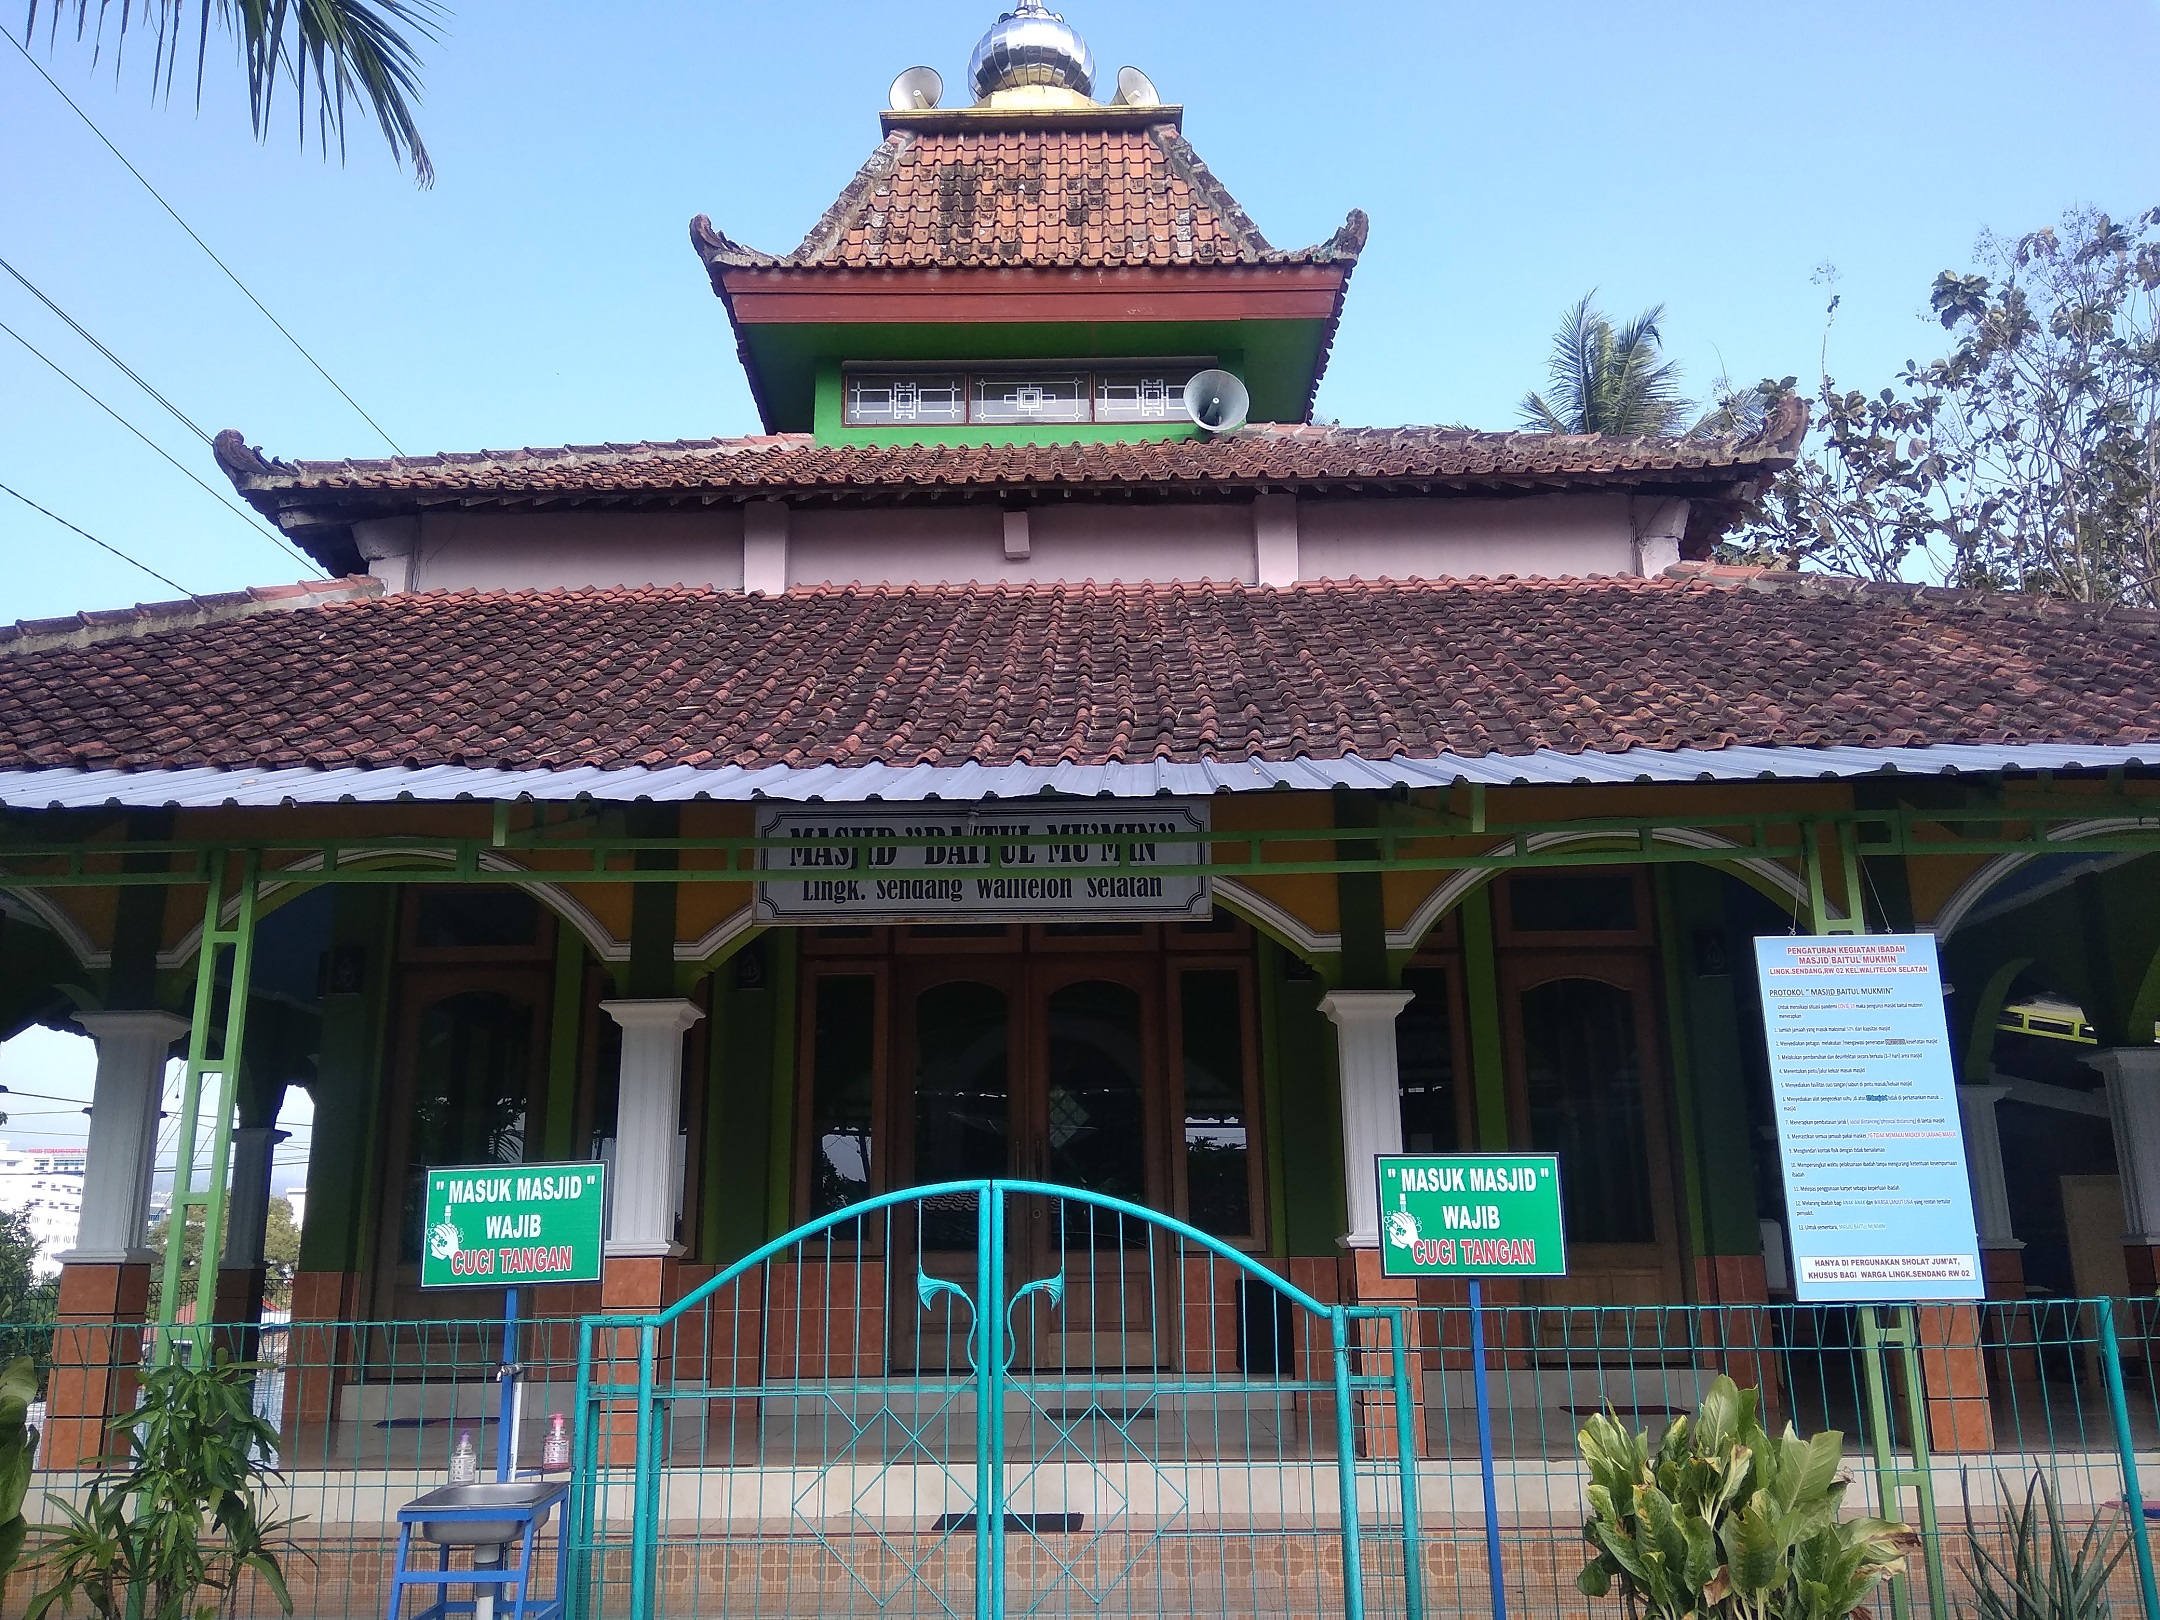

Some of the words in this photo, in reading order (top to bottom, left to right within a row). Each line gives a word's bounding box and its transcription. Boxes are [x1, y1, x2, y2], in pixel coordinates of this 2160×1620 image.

[1787, 946, 1837, 955] PENGATURAN
[1839, 946, 1876, 954] KEGIATAN
[1877, 945, 1906, 953] IBADAH
[1798, 956, 1829, 964] MASJID
[1831, 956, 1861, 964] BAITUL
[1862, 955, 1897, 963] MUKMIN
[448, 1178, 513, 1204] MASUK
[516, 1175, 582, 1201] MASJID
[1401, 1168, 1466, 1192] MASUK
[1469, 1167, 1537, 1192] MASJID
[485, 1214, 542, 1239] WAJIB
[1442, 1205, 1501, 1230] WAJIB
[451, 1248, 495, 1276] CUCI
[499, 1246, 573, 1274] TANGAN
[1412, 1239, 1457, 1266] CUCI
[1460, 1238, 1536, 1265] TANGAN
[1814, 1259, 1840, 1267] HANYA
[1841, 1259, 1850, 1267] DI
[1850, 1258, 1900, 1267] PERGUNAKAN
[1901, 1258, 1930, 1266] SHOLAT
[1807, 1271, 1839, 1279] KHUSUS
[1840, 1271, 1858, 1279] BAGI
[1860, 1270, 1888, 1278] WARGA
